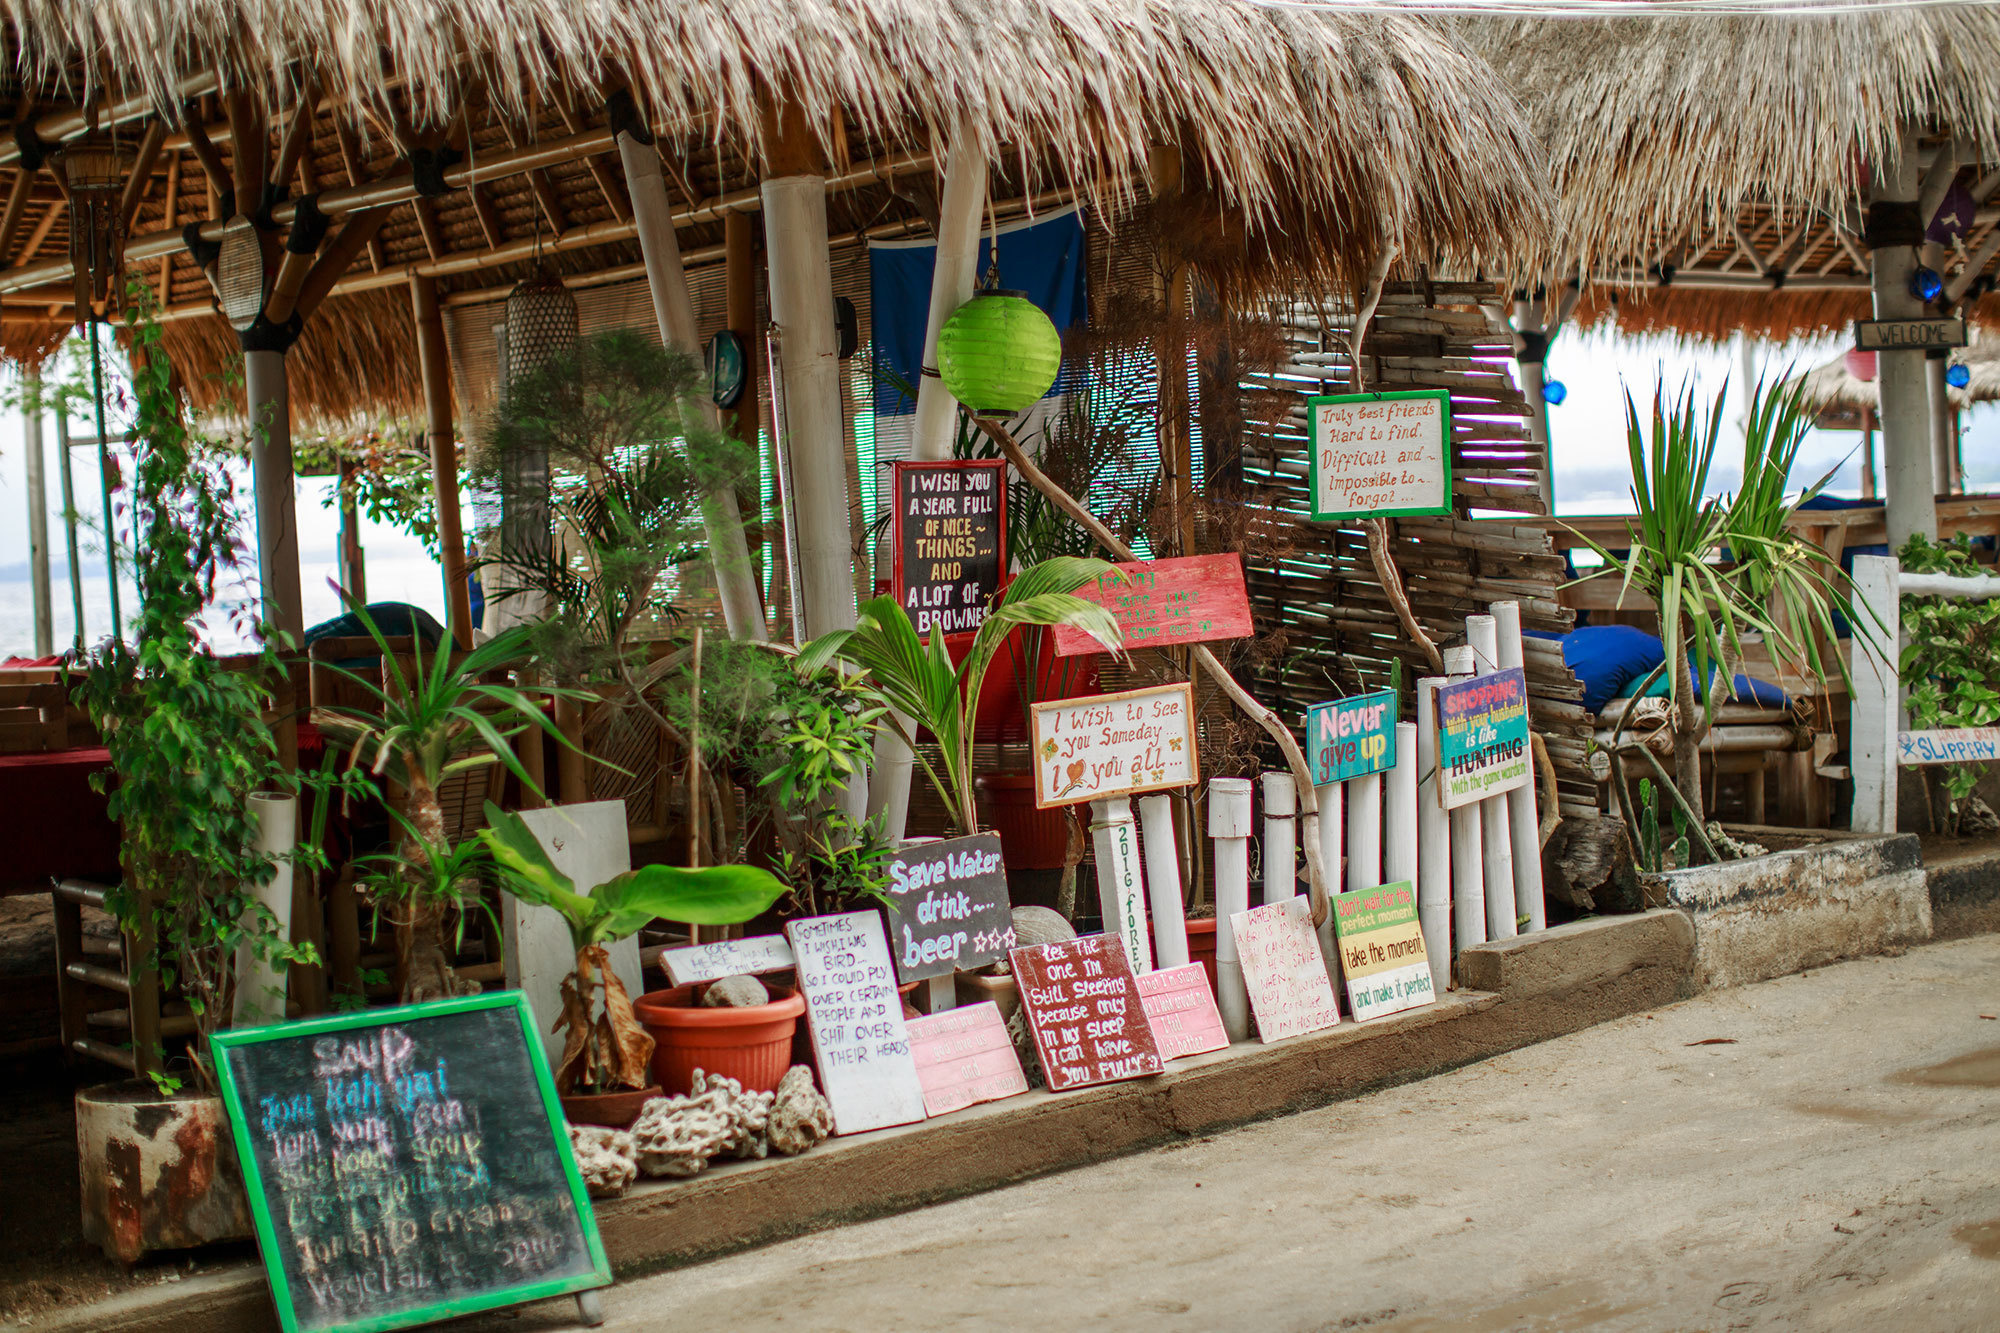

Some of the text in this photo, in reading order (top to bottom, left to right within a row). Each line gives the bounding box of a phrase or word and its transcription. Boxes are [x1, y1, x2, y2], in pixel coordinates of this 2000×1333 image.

[1877, 323, 1948, 345] WELCOME
[1321, 409, 1353, 427] Truly
[1386, 401, 1435, 422] friends
[1330, 426, 1366, 443] Hard
[1370, 426, 1383, 440] to
[1398, 446, 1424, 463] and
[911, 473, 990, 493] I WISH YOU
[1401, 470, 1415, 484] to
[909, 496, 992, 515] A YEAR FULL
[925, 518, 972, 536] OF NICE
[931, 561, 961, 581] AND
[1099, 572, 1155, 589] feeing
[907, 582, 979, 608] A LOT OF
[1116, 595, 1150, 608] same
[1166, 604, 1190, 617] bus
[1446, 679, 1517, 714] SHOPPING
[1054, 712, 1061, 733] I
[1127, 704, 1143, 721] to
[1319, 702, 1386, 742] Never
[1469, 712, 1489, 734] your
[1490, 696, 1524, 724] husband
[1061, 735, 1090, 758] you
[1466, 725, 1497, 748] is like
[1319, 733, 1386, 783] give up
[1451, 737, 1523, 777] HUNTING
[1053, 765, 1060, 792] I
[1087, 760, 1123, 789] you
[1470, 774, 1482, 790] the
[1483, 770, 1500, 791] game
[1501, 760, 1526, 779] warden
[889, 849, 1000, 894] Save Water
[1337, 888, 1410, 917] Don't wait for the
[1341, 904, 1413, 935] perfect moment
[804, 943, 810, 954] I
[849, 933, 867, 949] WAS
[903, 923, 968, 968] beer
[1073, 938, 1099, 956] The
[1346, 931, 1424, 969] take the moment
[822, 975, 827, 985] I
[1356, 972, 1432, 1008] and make it perfect
[811, 984, 894, 1006] OVER CERTAIN
[861, 1004, 886, 1019] AND
[820, 1025, 844, 1046] SHIT
[855, 1022, 894, 1041] OVER
[1176, 1034, 1204, 1055] better
[829, 1039, 909, 1067] THEIR HEADS
[1095, 1039, 1132, 1058] have
[961, 1057, 981, 1080] and
